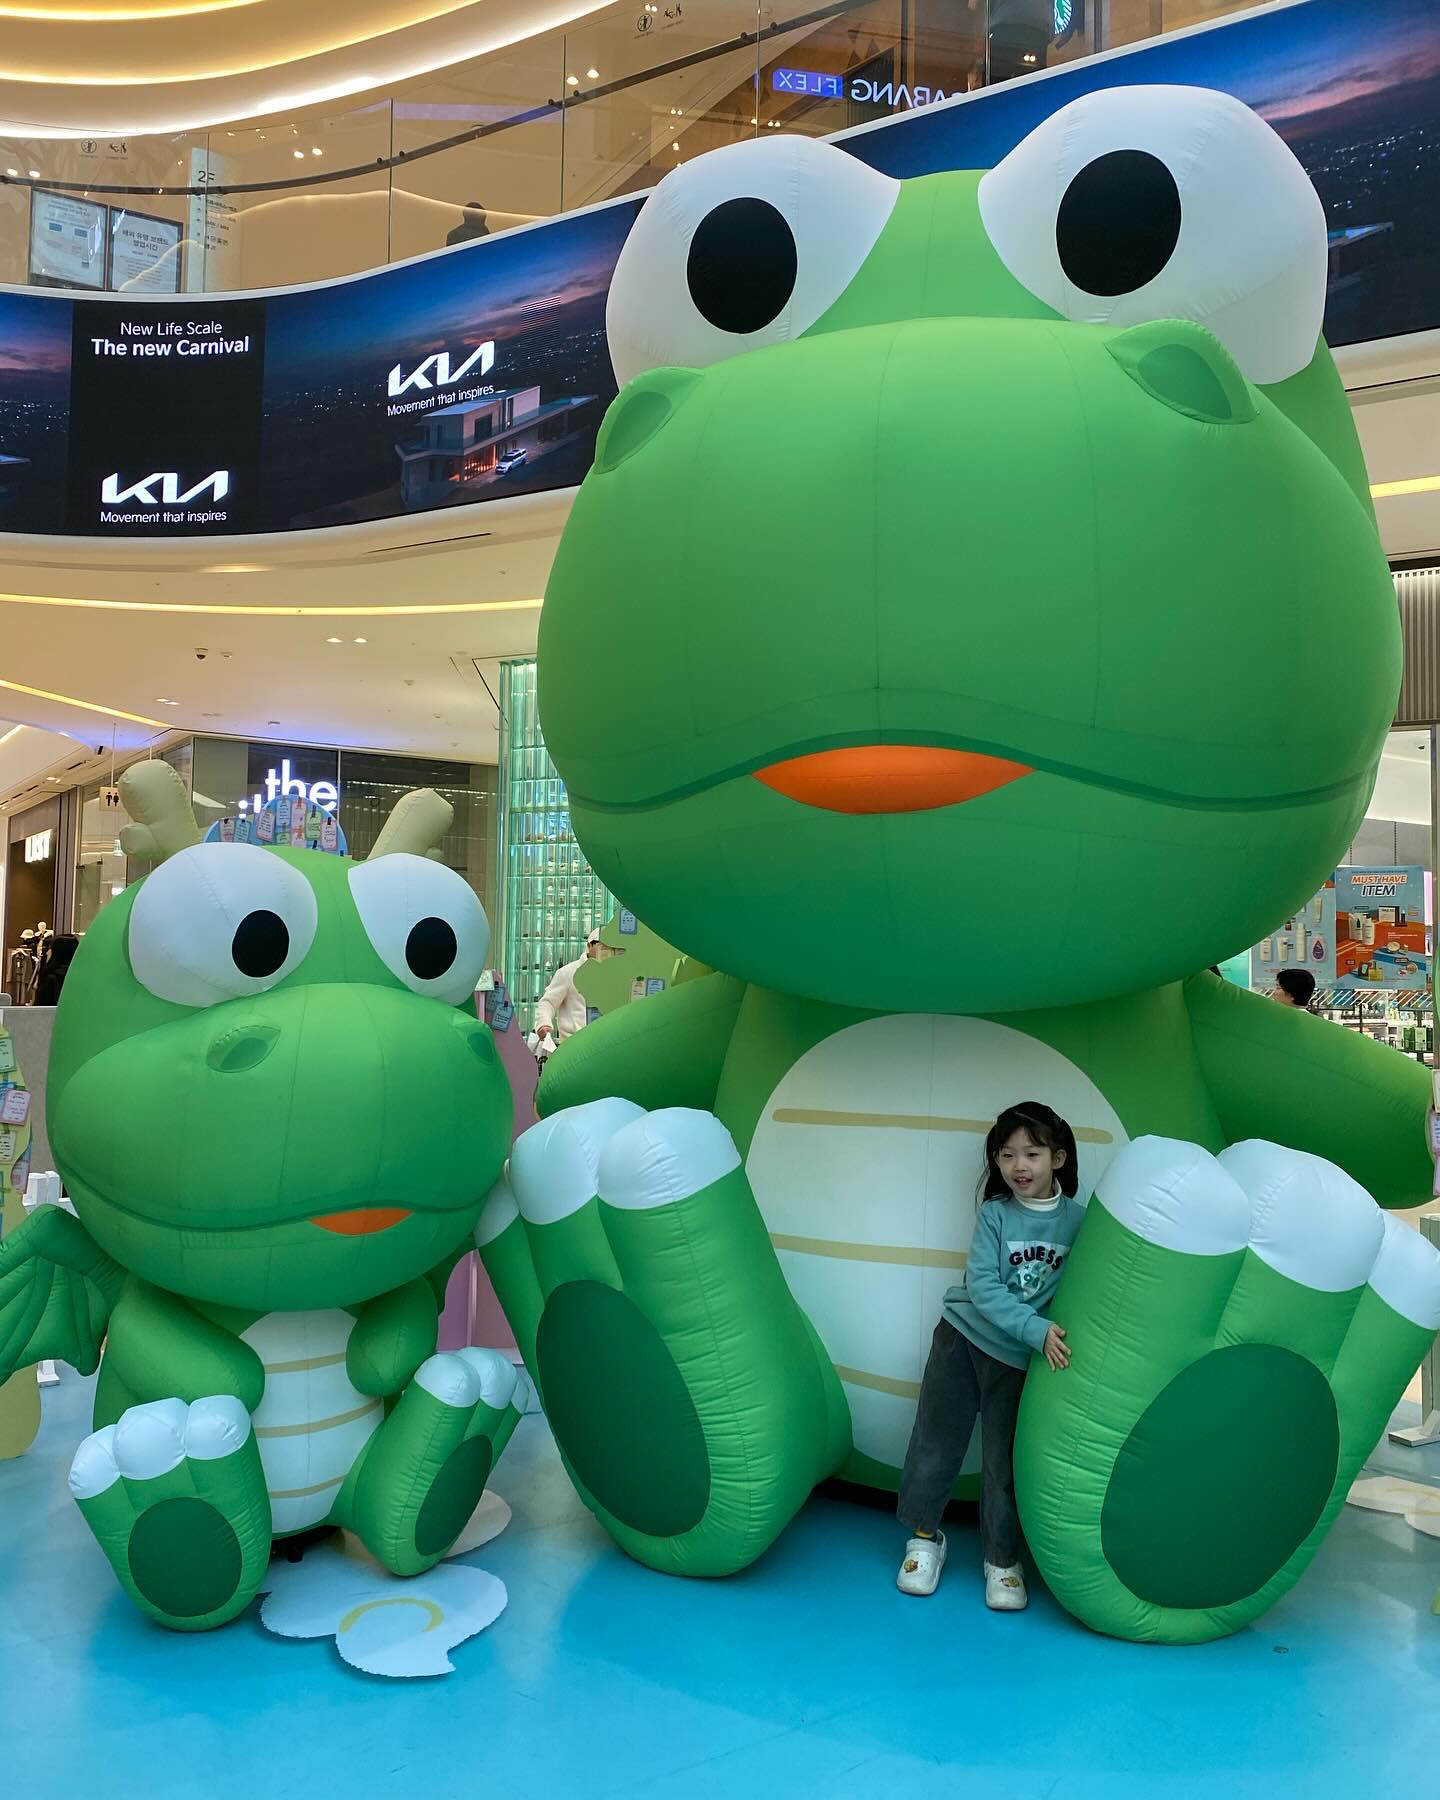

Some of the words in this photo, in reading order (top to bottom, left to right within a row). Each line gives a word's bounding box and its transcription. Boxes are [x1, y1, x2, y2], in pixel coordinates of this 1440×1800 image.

[120, 322, 153, 336] New
[157, 322, 183, 336] Life
[186, 320, 223, 335] Scale
[91, 338, 128, 356] The
[132, 342, 172, 356] new
[176, 335, 250, 356] Carnival
[388, 340, 495, 397] KIA
[387, 396, 435, 417] Movement
[437, 392, 456, 405] that
[458, 384, 495, 401] inspires
[102, 470, 229, 504] KIA
[100, 511, 160, 523] Movement
[163, 511, 185, 523] that
[187, 510, 227, 524] inspires
[265, 759, 338, 812] the
[1352, 875, 1380, 885] MUST
[1381, 874, 1408, 884] HAVE
[1361, 884, 1397, 897] ITEM
[1009, 1245, 1064, 1271] GUESS
